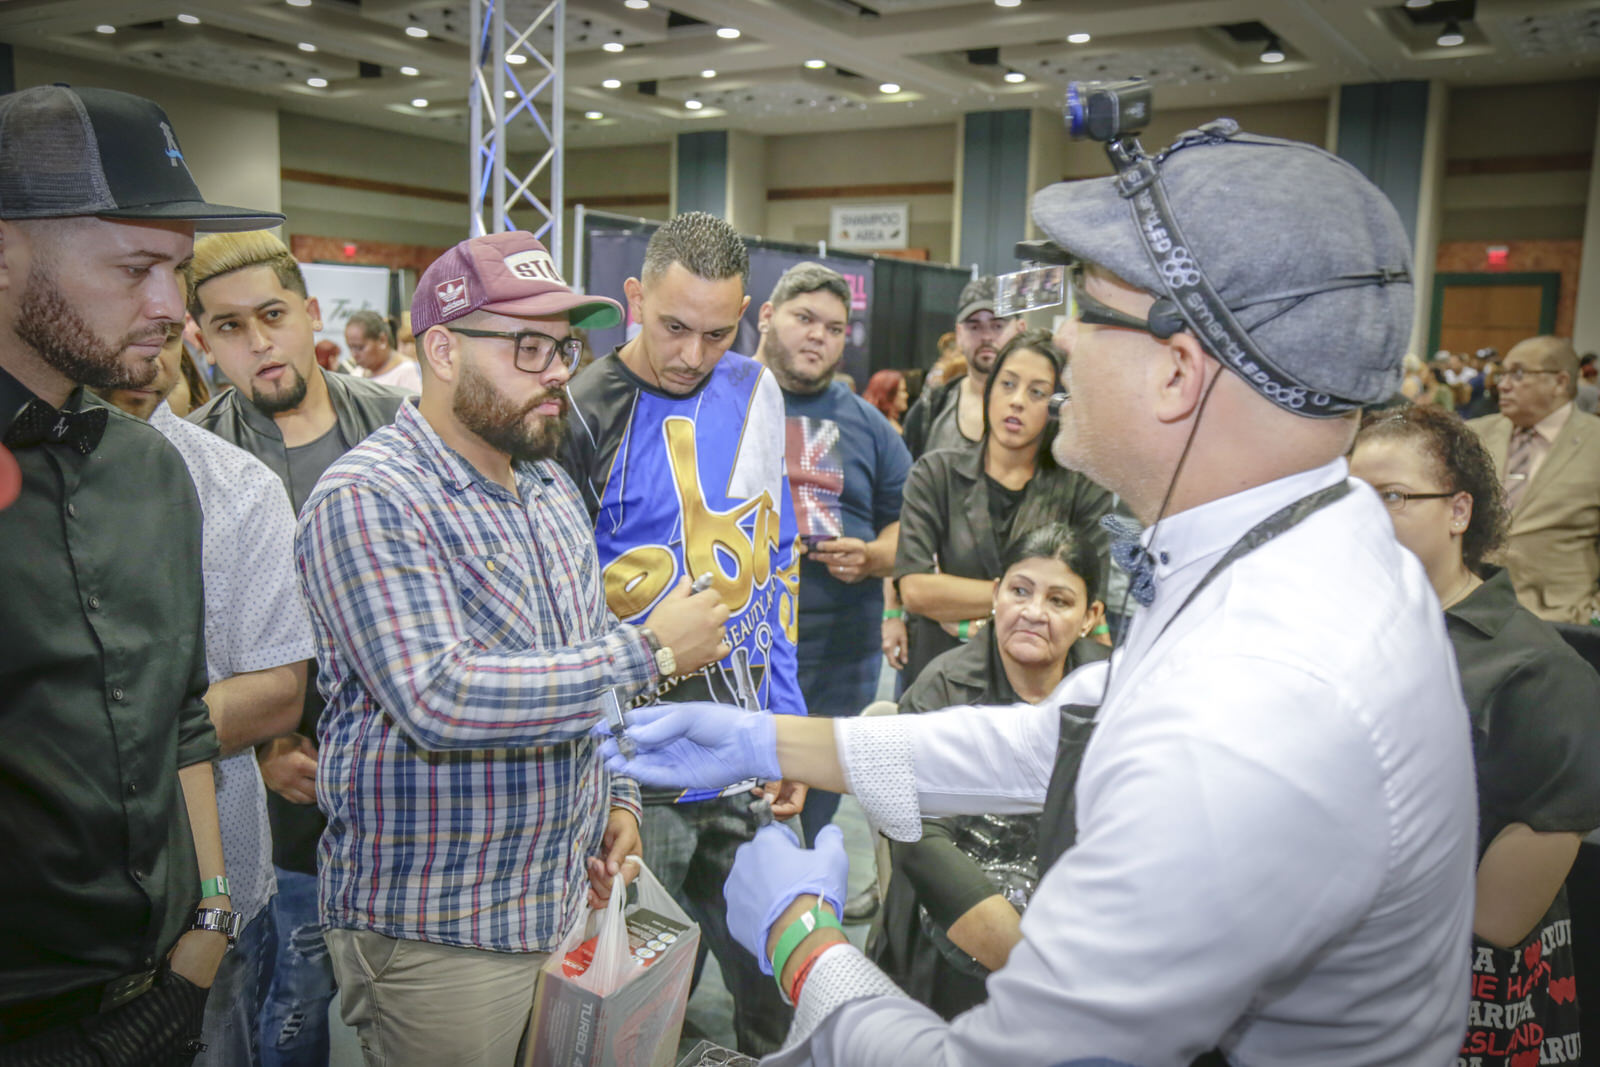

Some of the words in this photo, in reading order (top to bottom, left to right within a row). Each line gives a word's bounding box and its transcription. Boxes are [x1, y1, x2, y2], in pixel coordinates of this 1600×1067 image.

[841, 212, 900, 226] SHAMPOO
[855, 229, 885, 241] AREA
[441, 298, 465, 313] adidas
[721, 595, 765, 650] BEAUTY
[575, 1002, 593, 1055] TURBO
[1540, 1032, 1582, 1065] ARU
